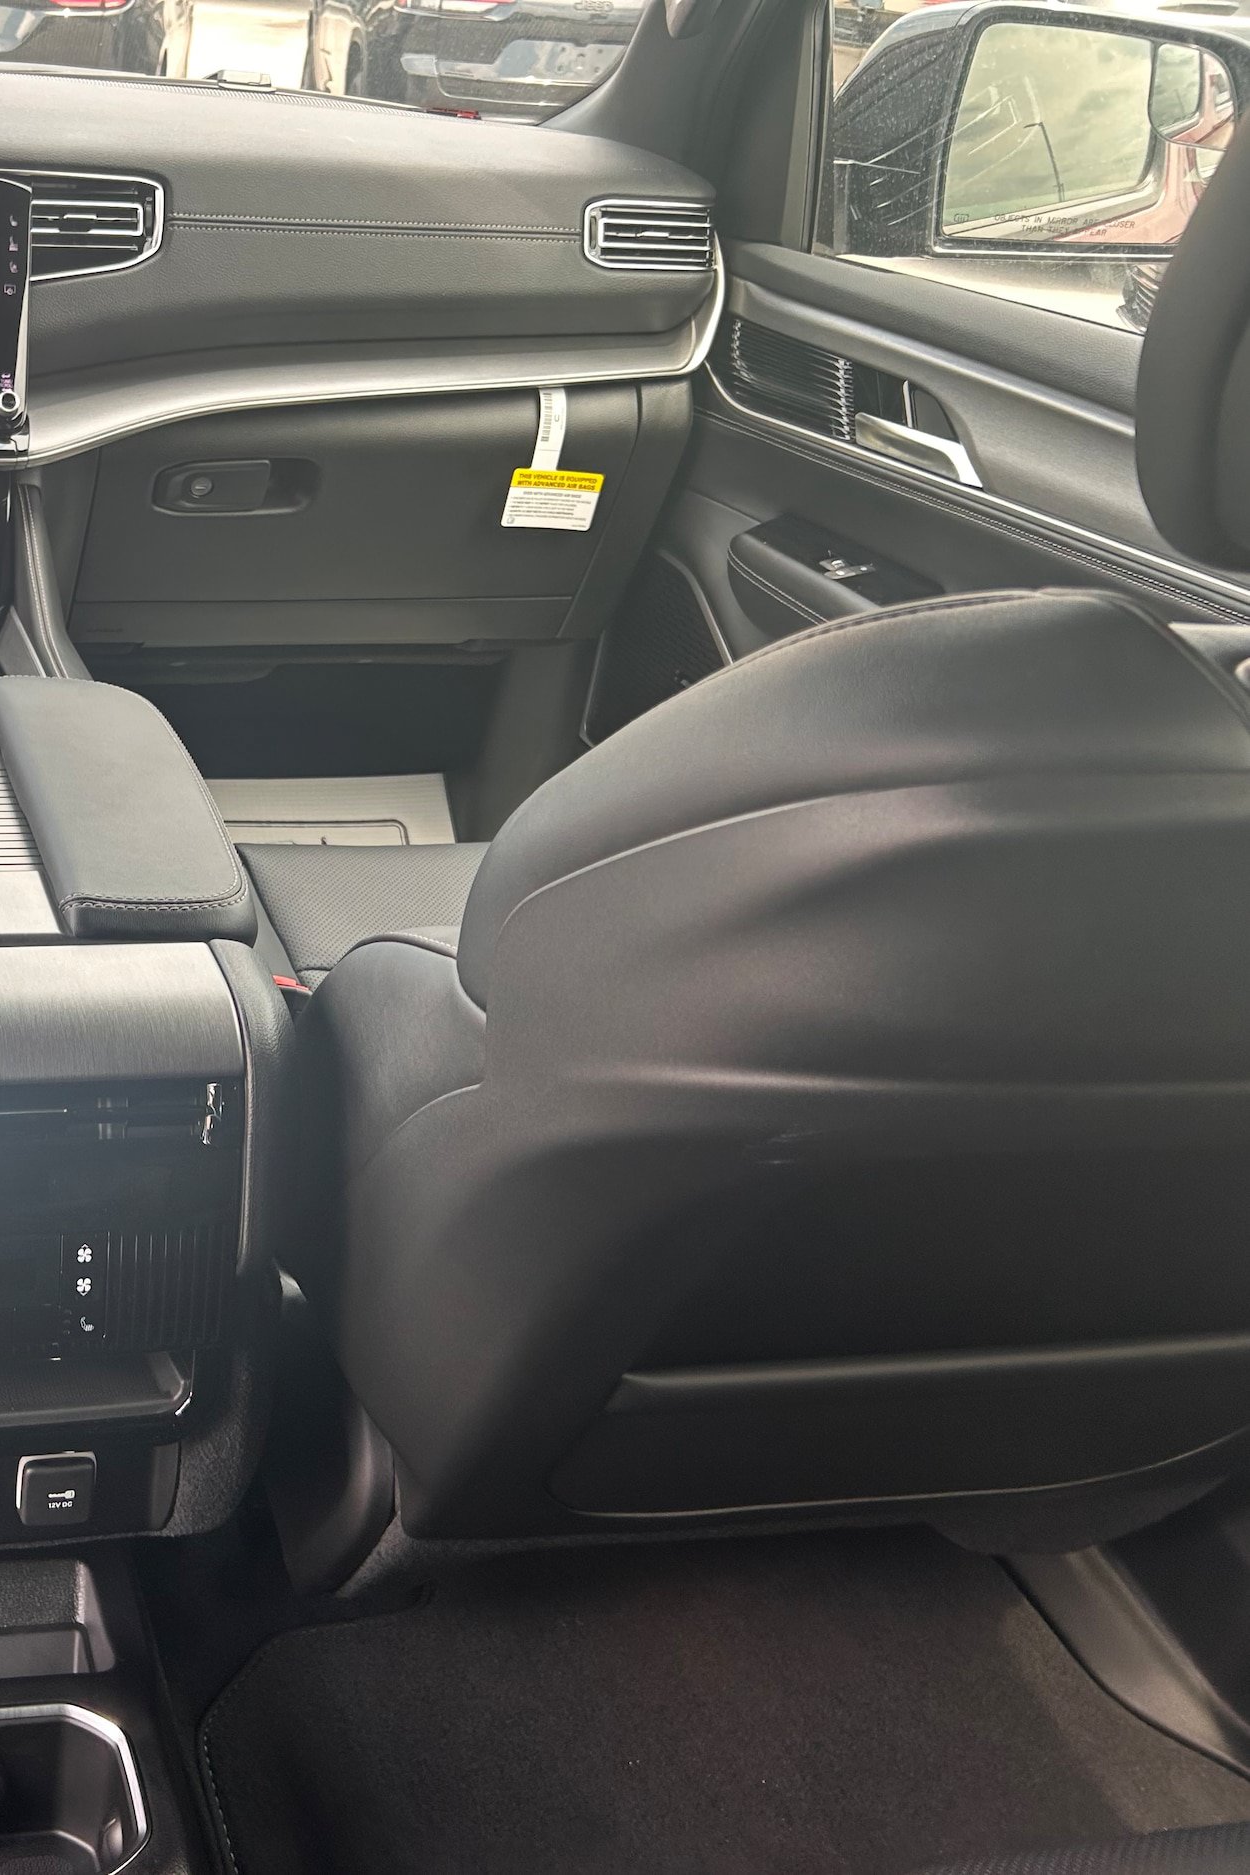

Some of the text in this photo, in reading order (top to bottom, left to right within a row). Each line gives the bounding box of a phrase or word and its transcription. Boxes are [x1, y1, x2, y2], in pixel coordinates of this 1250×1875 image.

[994, 215, 1030, 223] OBJECTS
[1048, 216, 1078, 224] MIRROR
[1021, 224, 1043, 232] THAN
[566, 475, 597, 483] EQUIPPED
[533, 480, 565, 488] ADVANCED
